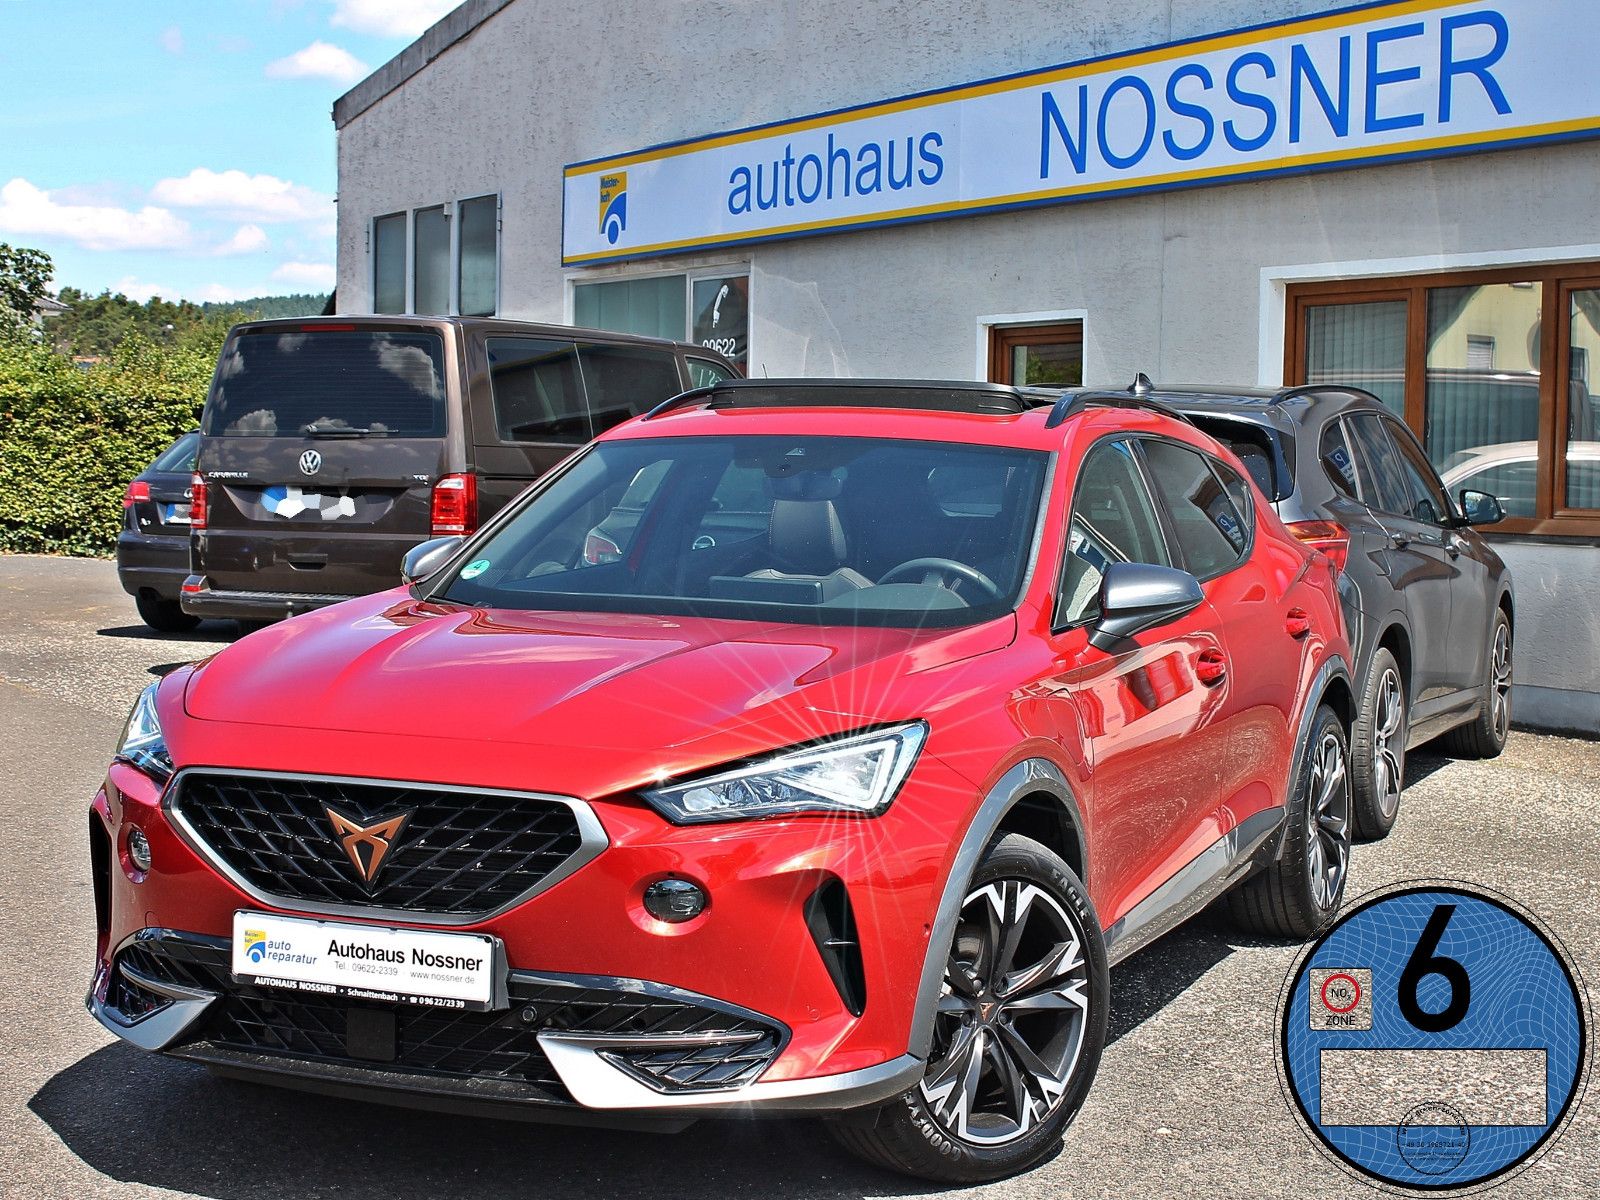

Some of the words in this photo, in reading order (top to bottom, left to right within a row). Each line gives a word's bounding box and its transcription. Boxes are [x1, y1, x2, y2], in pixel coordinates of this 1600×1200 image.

[728, 131, 944, 215] autohaus
[1039, 10, 1512, 179] NOSSNER
[1051, 867, 1091, 920] EAGLE
[267, 940, 291, 951] auto
[267, 951, 318, 965] reparatur
[327, 939, 405, 964] Autohaus
[412, 948, 483, 972] Nossner
[254, 976, 298, 989] AUTOHAUS
[299, 982, 337, 994] NOSSNER
[347, 987, 399, 1001] Schnaittenbach
